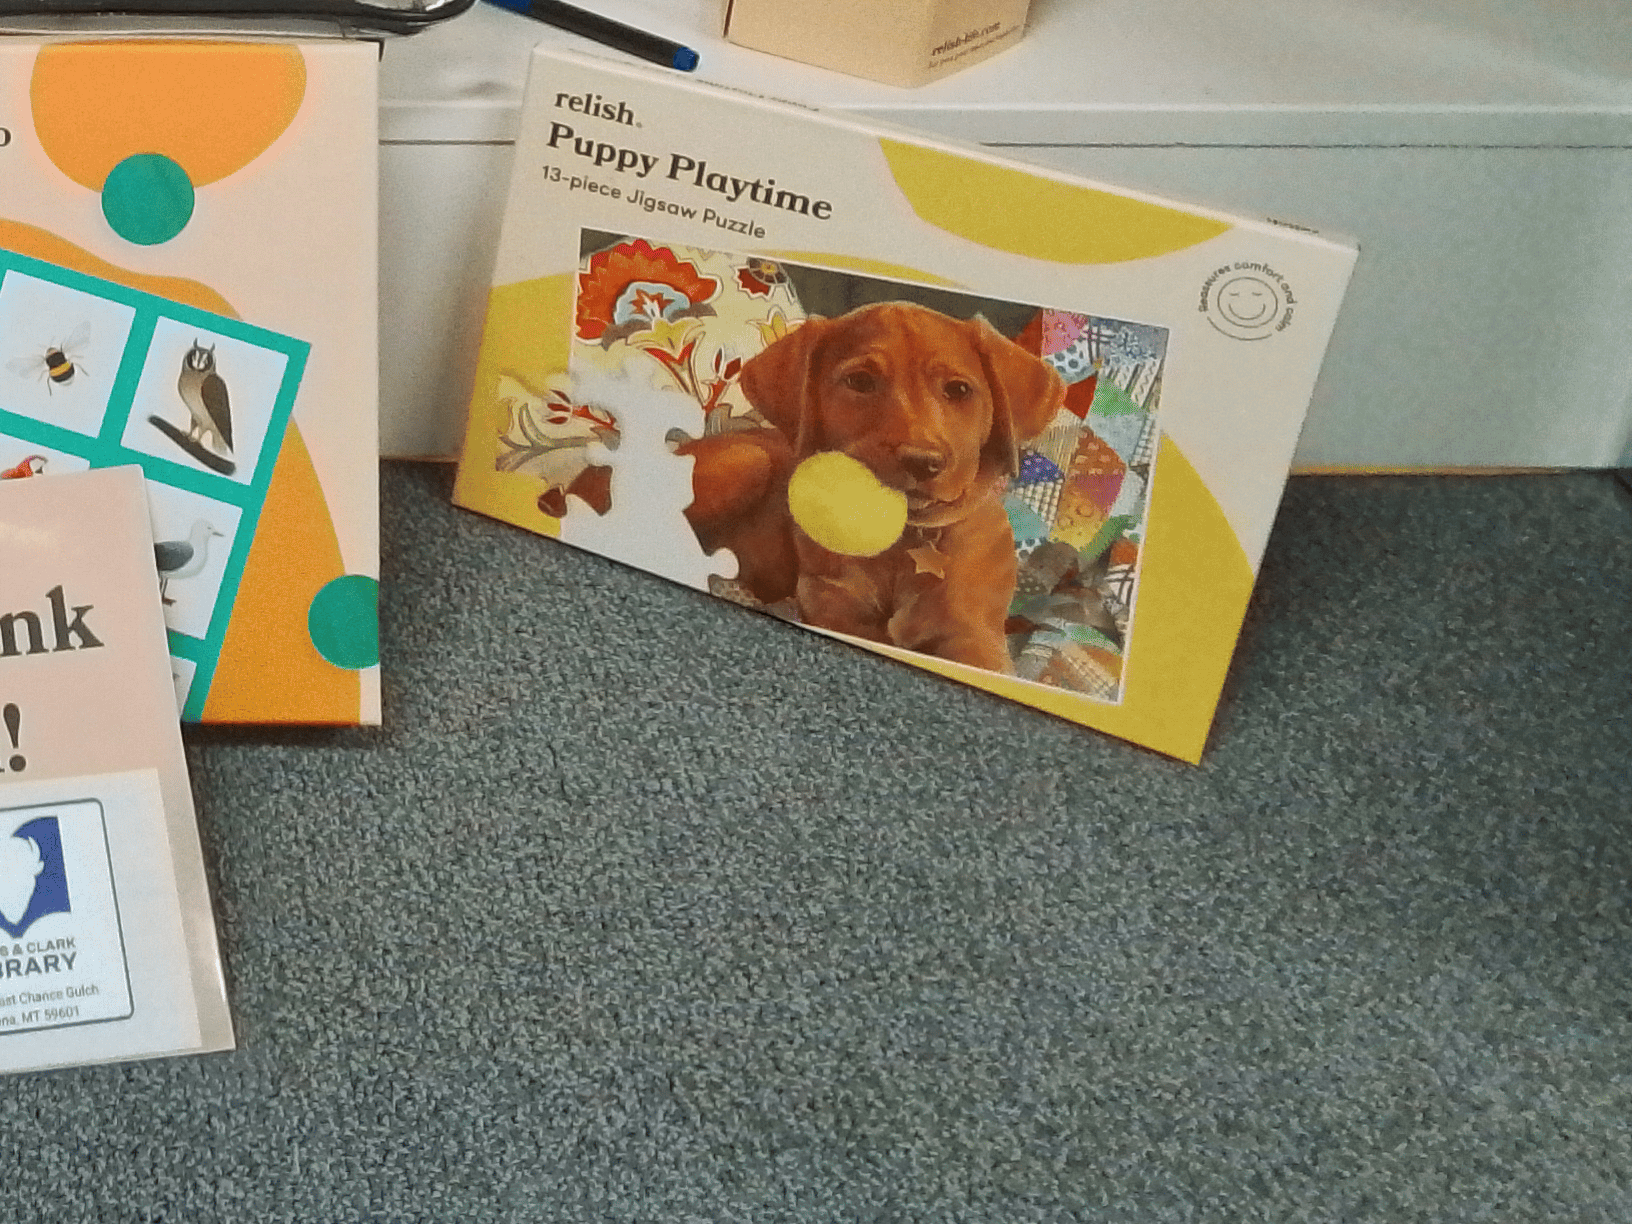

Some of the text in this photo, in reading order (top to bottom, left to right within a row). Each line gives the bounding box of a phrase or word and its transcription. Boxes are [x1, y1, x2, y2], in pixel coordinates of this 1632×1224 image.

[546, 121, 833, 221] Puppy Playtime
[541, 164, 766, 239] 13-piece Jigsaw Puzzle
[1233, 261, 1285, 284] comfort
[1280, 282, 1299, 305] and
[1274, 307, 1295, 332] calm
[12, 943, 24, 956] &
[26, 936, 77, 954] CLARK
[19, 989, 64, 1005] Chance
[66, 983, 100, 999] Gulch
[21, 1009, 40, 1024] MT
[44, 1004, 80, 1021] 59601
